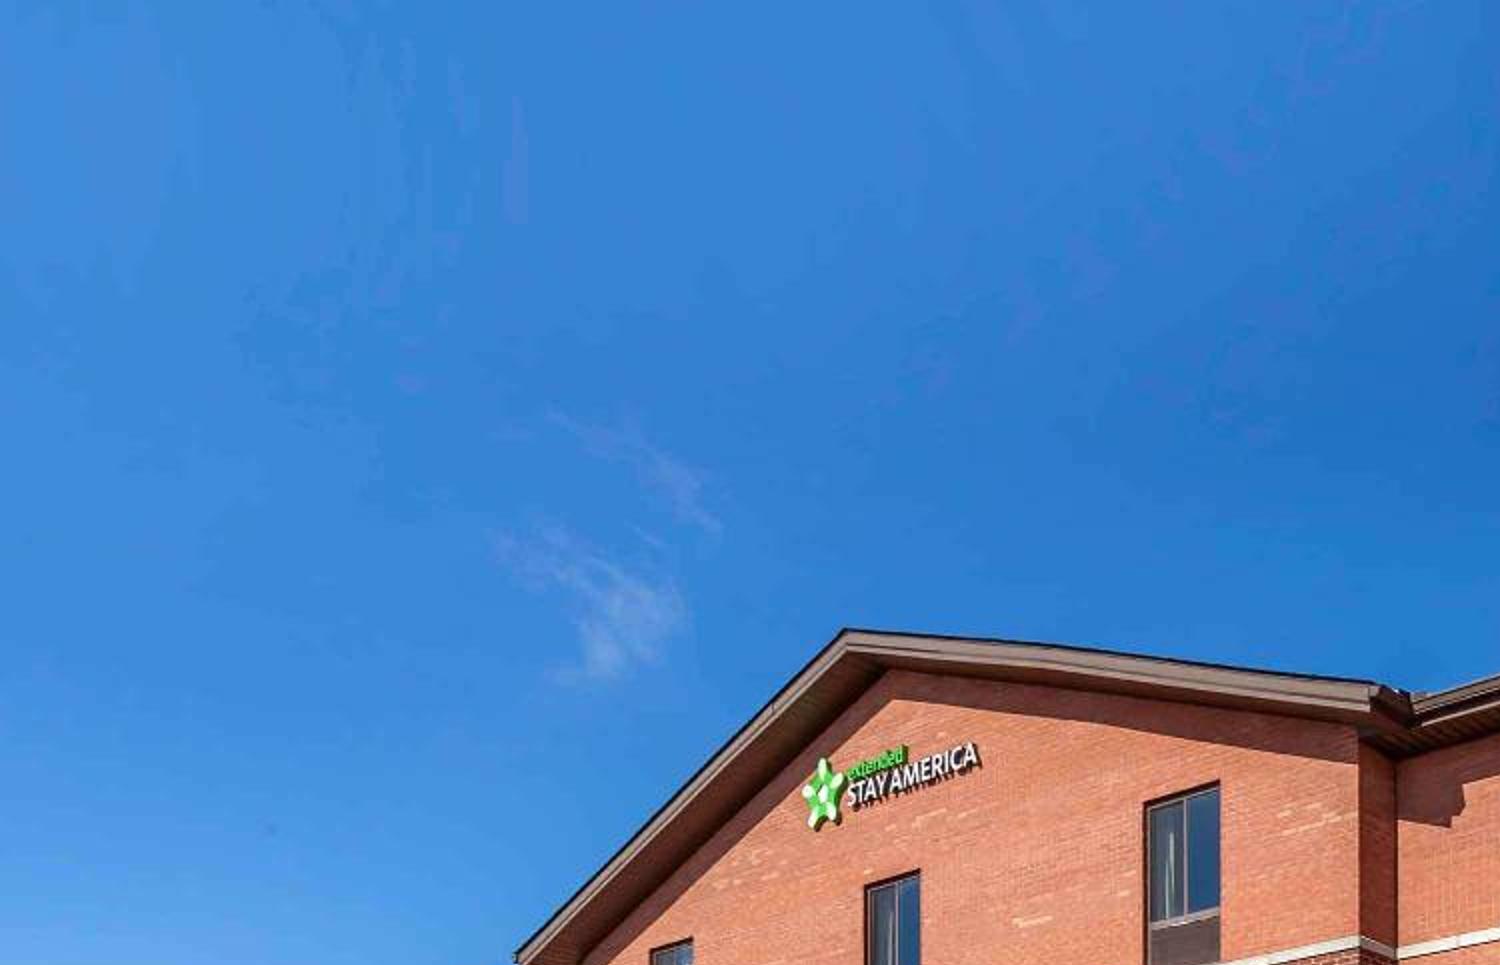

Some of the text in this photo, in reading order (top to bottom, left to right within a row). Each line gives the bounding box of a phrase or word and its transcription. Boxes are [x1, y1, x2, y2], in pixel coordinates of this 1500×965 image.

[847, 742, 978, 807] STAY AMERICA
[848, 745, 904, 780] extended
